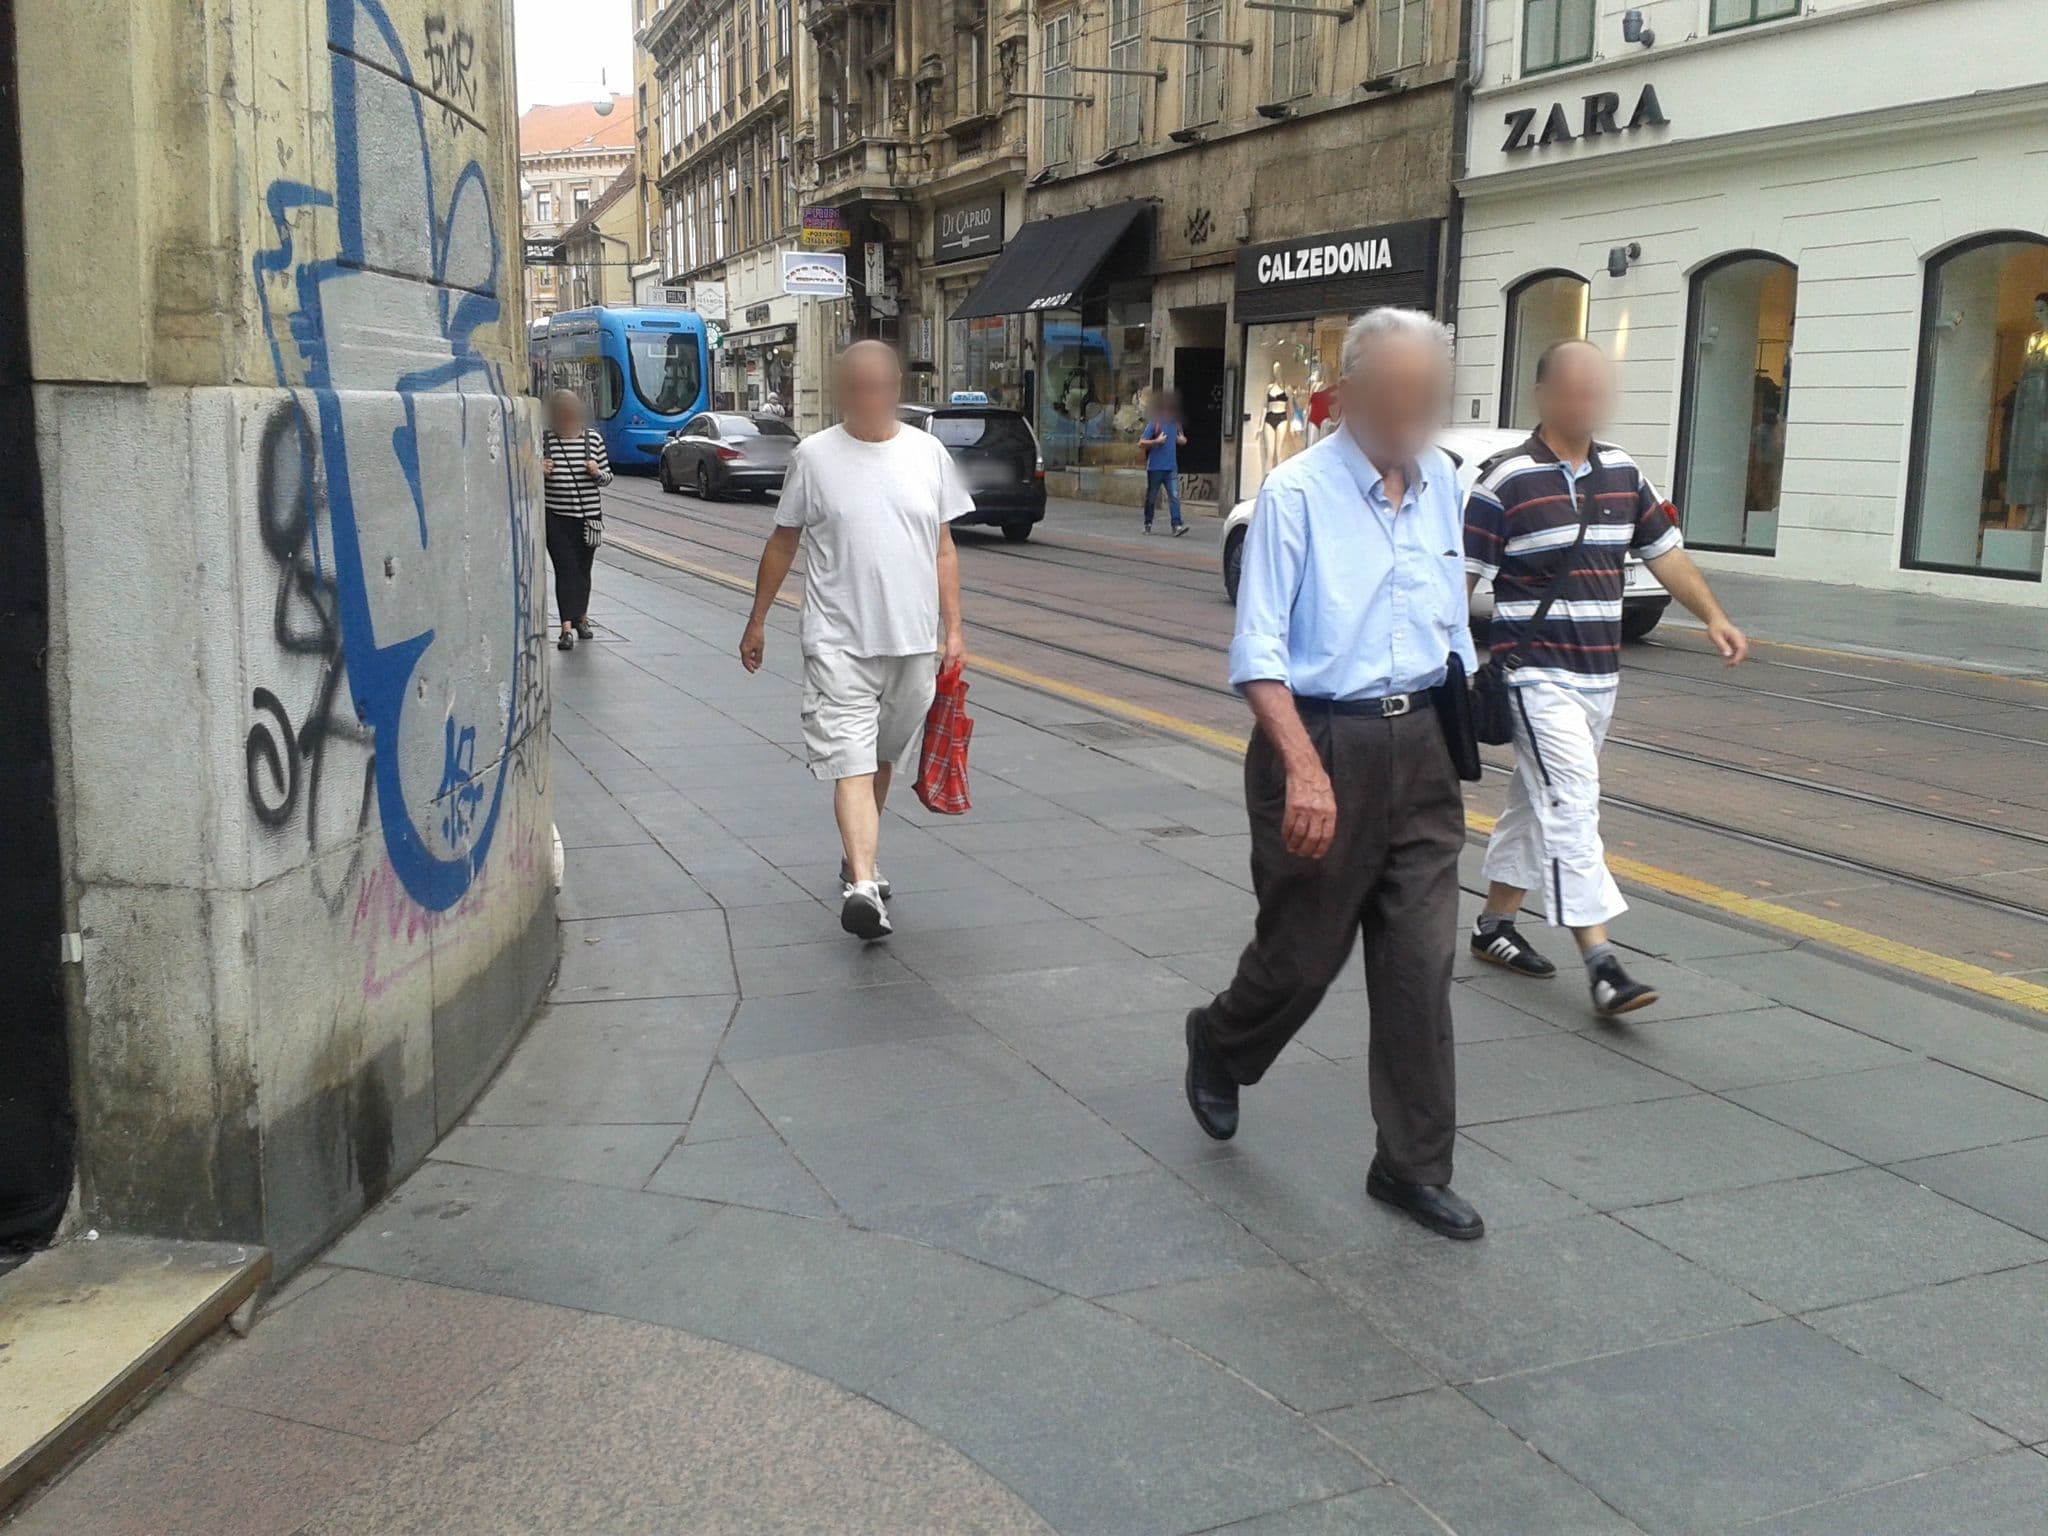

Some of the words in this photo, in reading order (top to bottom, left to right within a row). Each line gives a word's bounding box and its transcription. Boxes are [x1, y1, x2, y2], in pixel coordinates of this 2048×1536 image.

[1500, 83, 1671, 151] ZARA
[956, 207, 991, 234] CAPRIO
[1257, 237, 1393, 284] CALZEDONIA
